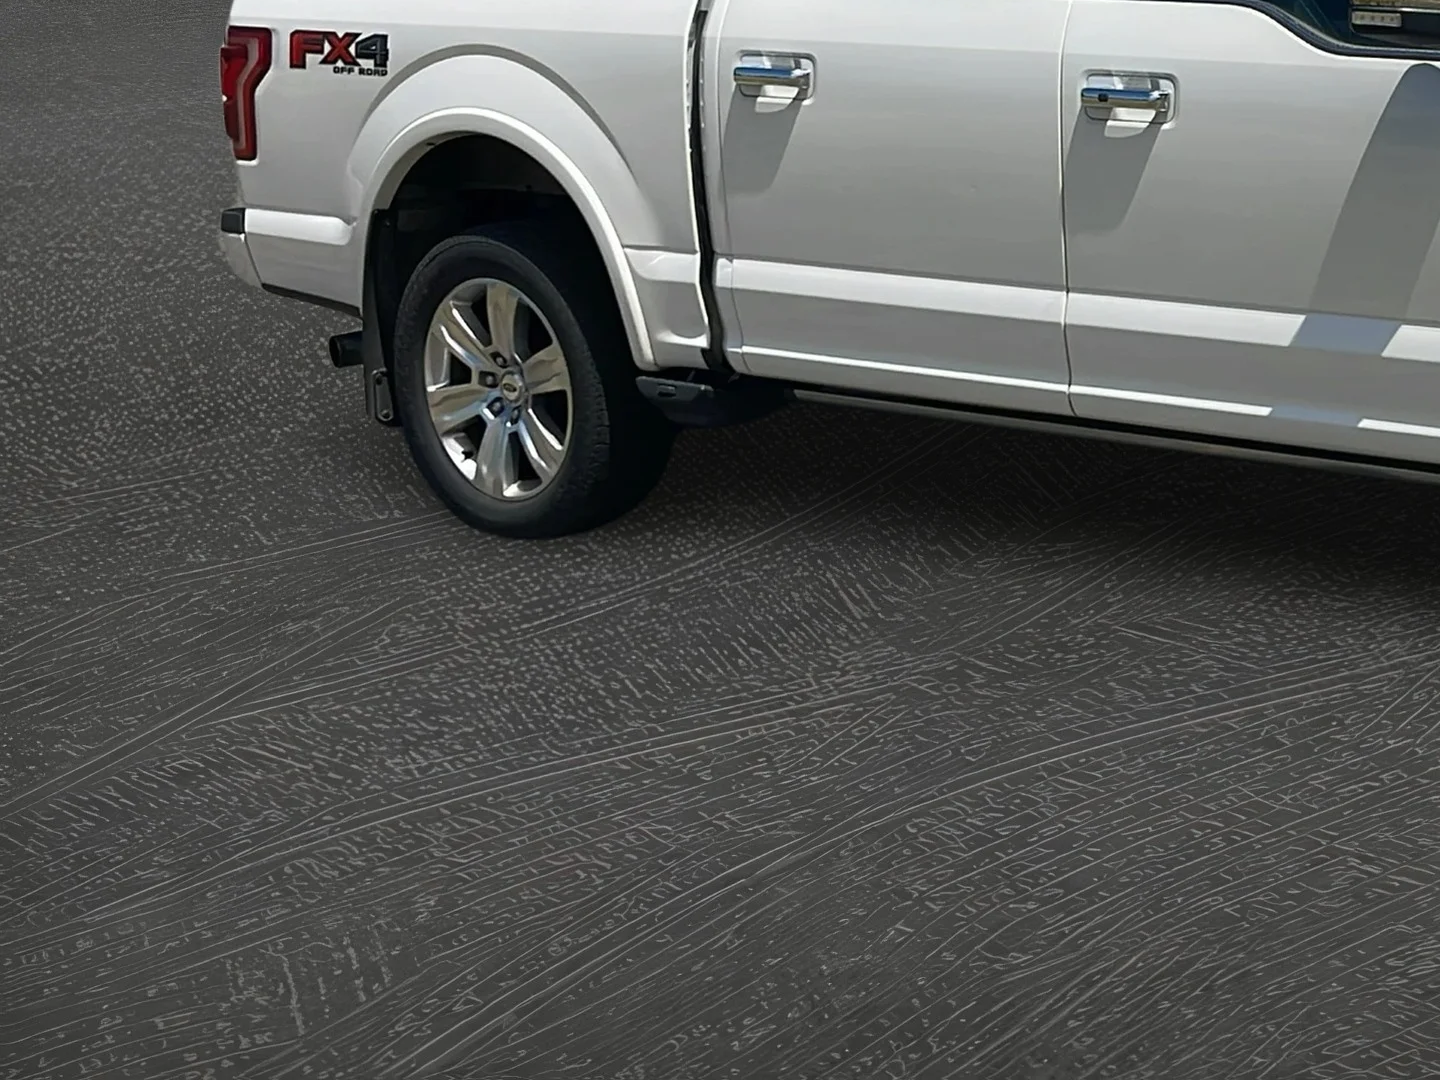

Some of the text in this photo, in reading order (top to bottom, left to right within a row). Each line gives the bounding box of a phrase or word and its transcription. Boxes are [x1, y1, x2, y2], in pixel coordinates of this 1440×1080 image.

[289, 29, 389, 69] FX4
[333, 66, 388, 77] OFF ROAD
